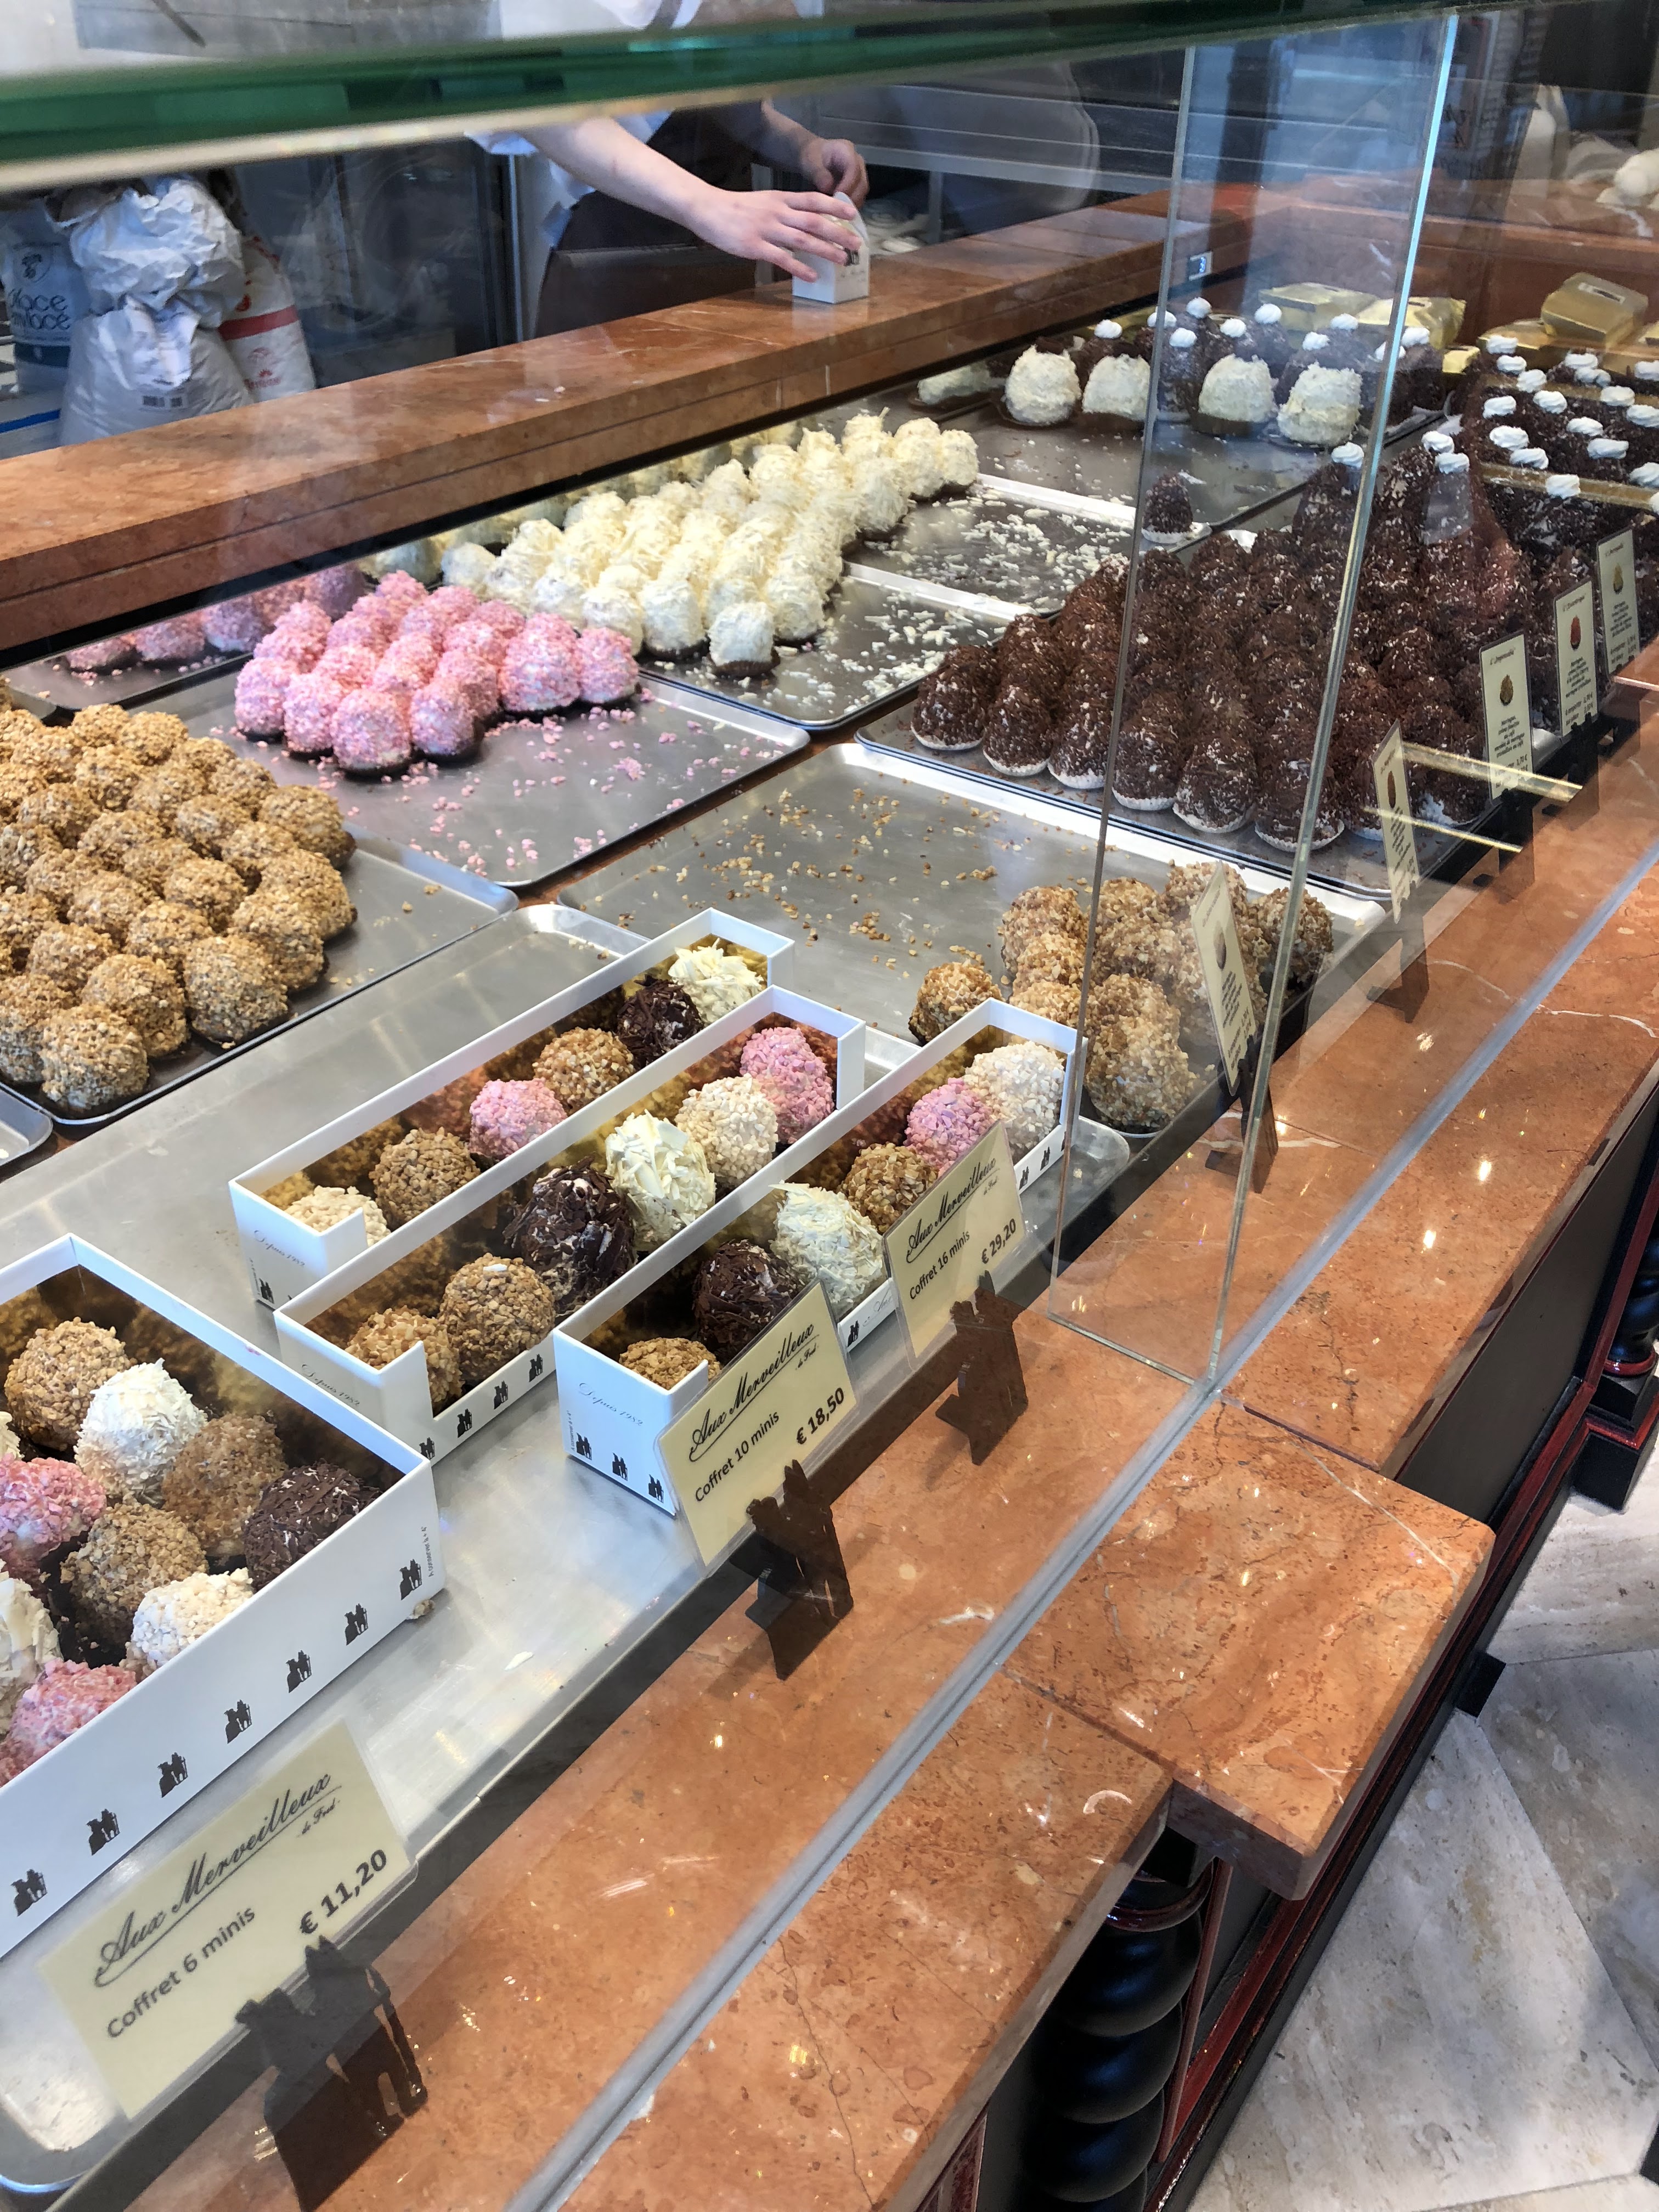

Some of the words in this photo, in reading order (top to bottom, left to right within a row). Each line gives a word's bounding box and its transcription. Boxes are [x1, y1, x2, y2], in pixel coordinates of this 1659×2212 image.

[907, 1218, 933, 1260] Aux
[935, 1158, 996, 1227] Merveilleux
[981, 1248, 989, 1264] €
[990, 1218, 1016, 1257] 29,20
[910, 1265, 938, 1300] Coffret
[938, 1251, 949, 1270] 16
[949, 1231, 970, 1258] minis
[578, 1383, 617, 1412] Depuis
[619, 1411, 643, 1426] 1982
[690, 1408, 727, 1457] Aux
[730, 1324, 814, 1414] Merveilleux
[797, 1427, 807, 1445] €
[808, 1387, 844, 1434] 18,50
[696, 1458, 734, 1502] Coffret
[735, 1440, 749, 1462] 10
[751, 1412, 779, 1445] minis
[312, 1798, 336, 1824] Fred
[95, 1910, 166, 1982] Aux
[172, 1774, 331, 1913] Merveilleux
[300, 1911, 319, 1934] €
[321, 1849, 387, 1917] 11,20
[107, 1971, 181, 2037] Coffret
[183, 1953, 198, 1973] 6
[202, 1908, 255, 1958] minis
